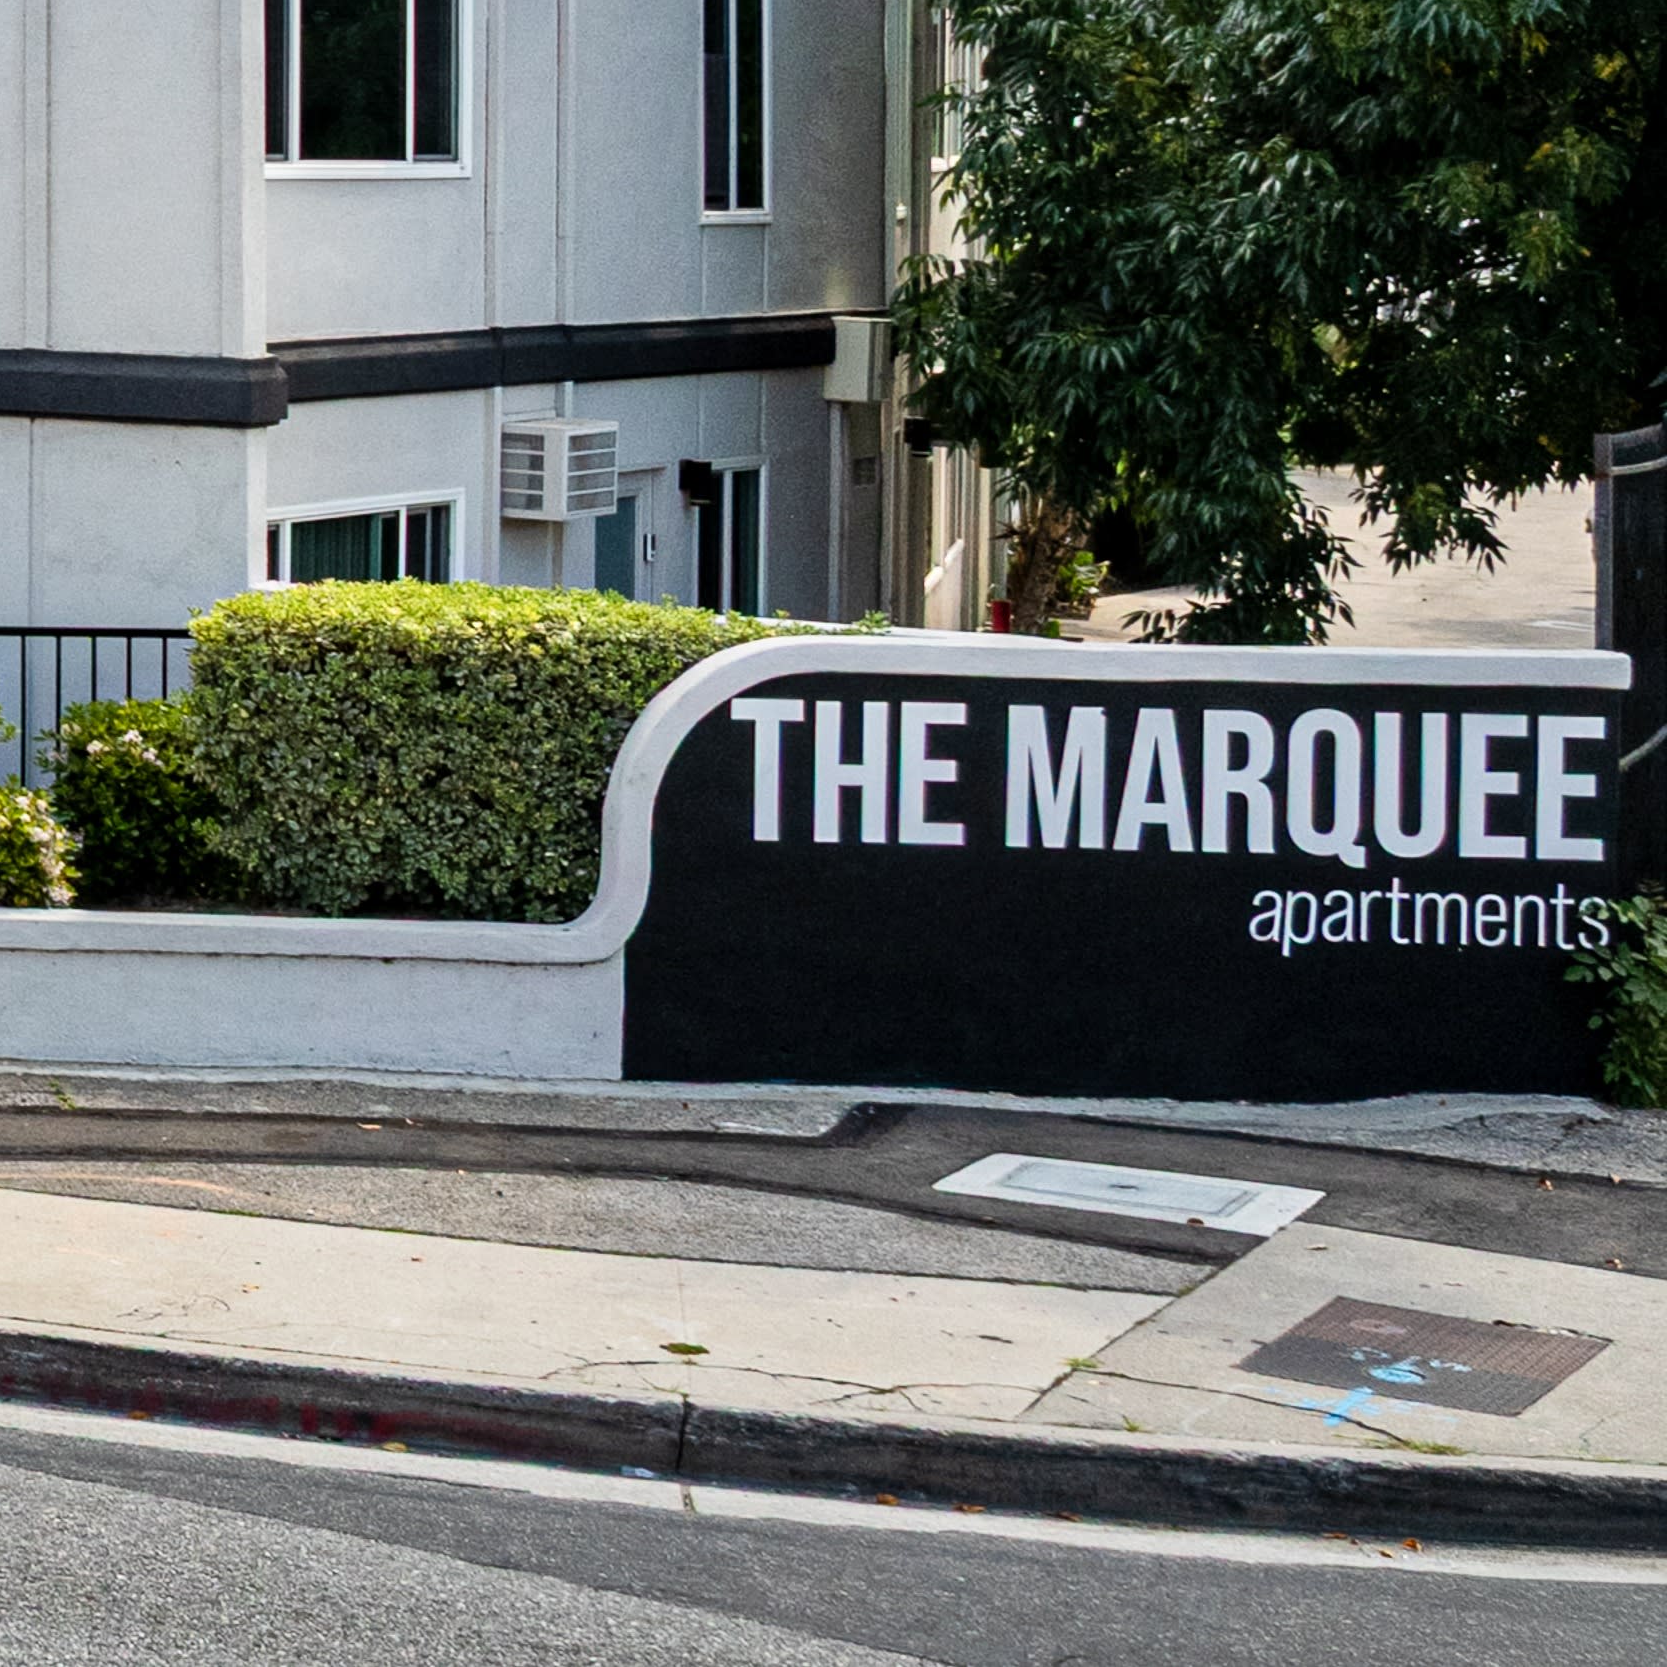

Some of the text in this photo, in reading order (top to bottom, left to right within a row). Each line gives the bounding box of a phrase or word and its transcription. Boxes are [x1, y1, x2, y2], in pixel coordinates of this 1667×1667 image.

[730, 697, 1606, 869] THE MARQUEE
[1248, 877, 1610, 957] apartments
